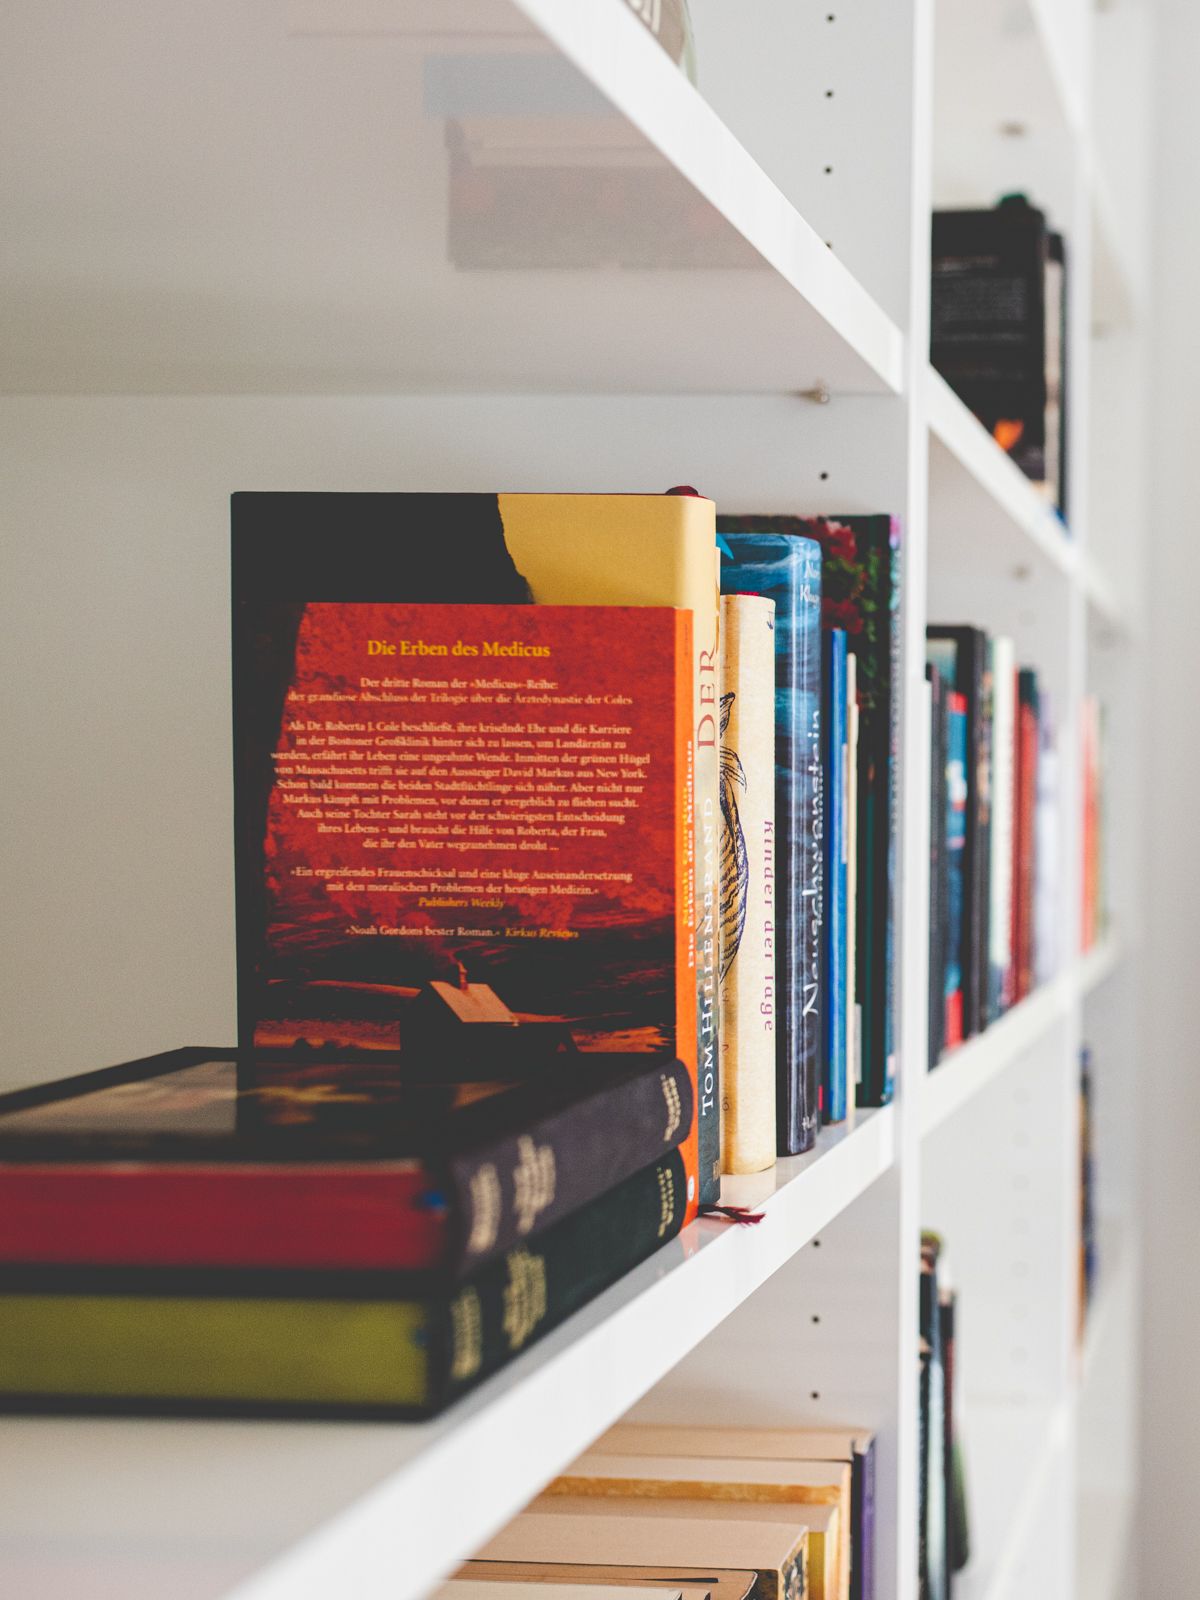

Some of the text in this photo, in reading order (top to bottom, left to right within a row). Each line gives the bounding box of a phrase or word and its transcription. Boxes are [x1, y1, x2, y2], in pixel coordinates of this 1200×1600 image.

[367, 639, 550, 658] Die Erben des Medicus
[360, 677, 380, 687] Der
[381, 678, 410, 688] dritte
[412, 678, 449, 688] Roman
[450, 678, 467, 688] der
[288, 691, 305, 701] der
[308, 691, 356, 702] grandiose
[410, 692, 426, 702] der
[431, 692, 467, 703] Trilogie
[471, 693, 492, 703] über
[496, 693, 510, 703] die
[515, 693, 582, 704] Ärztedynastie
[585, 694, 601, 704] der
[604, 694, 632, 704] Coles
[697, 649, 717, 750] DER
[288, 720, 305, 731] Als
[325, 721, 365, 732] Roberta
[376, 721, 399, 732] Cole
[457, 722, 476, 733] ihre
[479, 722, 524, 733] kriselnde
[528, 723, 546, 734] Ehe
[549, 723, 569, 734] und
[571, 723, 587, 734] die
[589, 724, 631, 735] Karriere
[296, 735, 307, 746] in
[308, 735, 325, 746] der
[328, 736, 373, 747] Bostoner
[375, 736, 430, 747] Großklinik
[432, 737, 462, 748] hinter
[465, 737, 485, 748] sich
[537, 741, 554, 749] um
[556, 738, 612, 749] Landärztin
[614, 742, 626, 750] zu
[311, 750, 347, 761] erfährt
[349, 750, 364, 761] ihr
[367, 750, 396, 761] Leben
[399, 751, 419, 762] eine
[422, 751, 473, 763] ungeahnte
[515, 752, 559, 763] Inmitten
[561, 753, 577, 764] der
[580, 753, 617, 765] grünen
[619, 754, 650, 766] Hügel
[274, 767, 293, 775] von
[296, 765, 367, 776] Massachusetts
[369, 765, 392, 776] trifft
[395, 766, 408, 777] sie
[411, 766, 427, 777] auf
[429, 766, 448, 777] den
[451, 767, 500, 779] Aussteiger
[503, 767, 533, 778] David
[536, 768, 574, 779] Markus
[576, 771, 594, 779] aus
[596, 768, 618, 779] New
[277, 778, 308, 789] Schon
[310, 779, 332, 790] bald
[334, 779, 379, 790] kommen
[381, 780, 396, 791] die
[398, 780, 432, 791] beiden
[435, 781, 512, 793] Stadtflüchtlinge
[515, 781, 534, 792] sich
[571, 782, 594, 793] Aber
[596, 783, 622, 794] nicht
[625, 786, 644, 794] nur
[283, 793, 321, 804] Markus
[323, 794, 359, 806] kämpft
[362, 794, 379, 805] mit
[459, 796, 489, 807] denen
[492, 799, 501, 807] er
[505, 796, 555, 808] vergeblich
[558, 800, 569, 808] zu
[572, 797, 606, 808] fliehen
[297, 808, 625, 824] Auch seine Tochter Sarah steht vor der schwierigsten Entscheidung
[317, 822, 342, 833] ihres
[344, 823, 379, 834] Lebens
[388, 823, 408, 834] und
[410, 824, 449, 835] braucht
[451, 824, 466, 835] die
[469, 824, 493, 835] Hilfe
[496, 828, 514, 836] von
[561, 825, 577, 836] der
[362, 838, 378, 848] die
[381, 838, 395, 848] ihr
[397, 839, 416, 849] den
[418, 839, 444, 849] Vater
[447, 840, 517, 851] wegzunehmen
[519, 841, 547, 851] droht
[764, 820, 775, 907] Kinder
[315, 867, 375, 879] ergreifendes
[378, 867, 456, 878] Frauenschicksal
[459, 868, 478, 879] und
[480, 868, 500, 879] eine
[503, 869, 529, 881] kluge
[533, 869, 632, 881] Auseinandersetzung
[327, 881, 344, 892] mit
[346, 881, 365, 892] den
[367, 882, 428, 893] moralischen
[430, 883, 484, 894] Problemen
[486, 883, 502, 894] der
[504, 884, 548, 896] heutigen
[419, 898, 504, 909] Publishers Weekly
[379, 926, 423, 937] Gordons
[425, 926, 454, 937] bester
[506, 927, 536, 938] Kirkus
[540, 928, 579, 939] Reviews
[764, 920, 775, 960] der
[702, 797, 714, 1116] TOM HILLENBRAND
